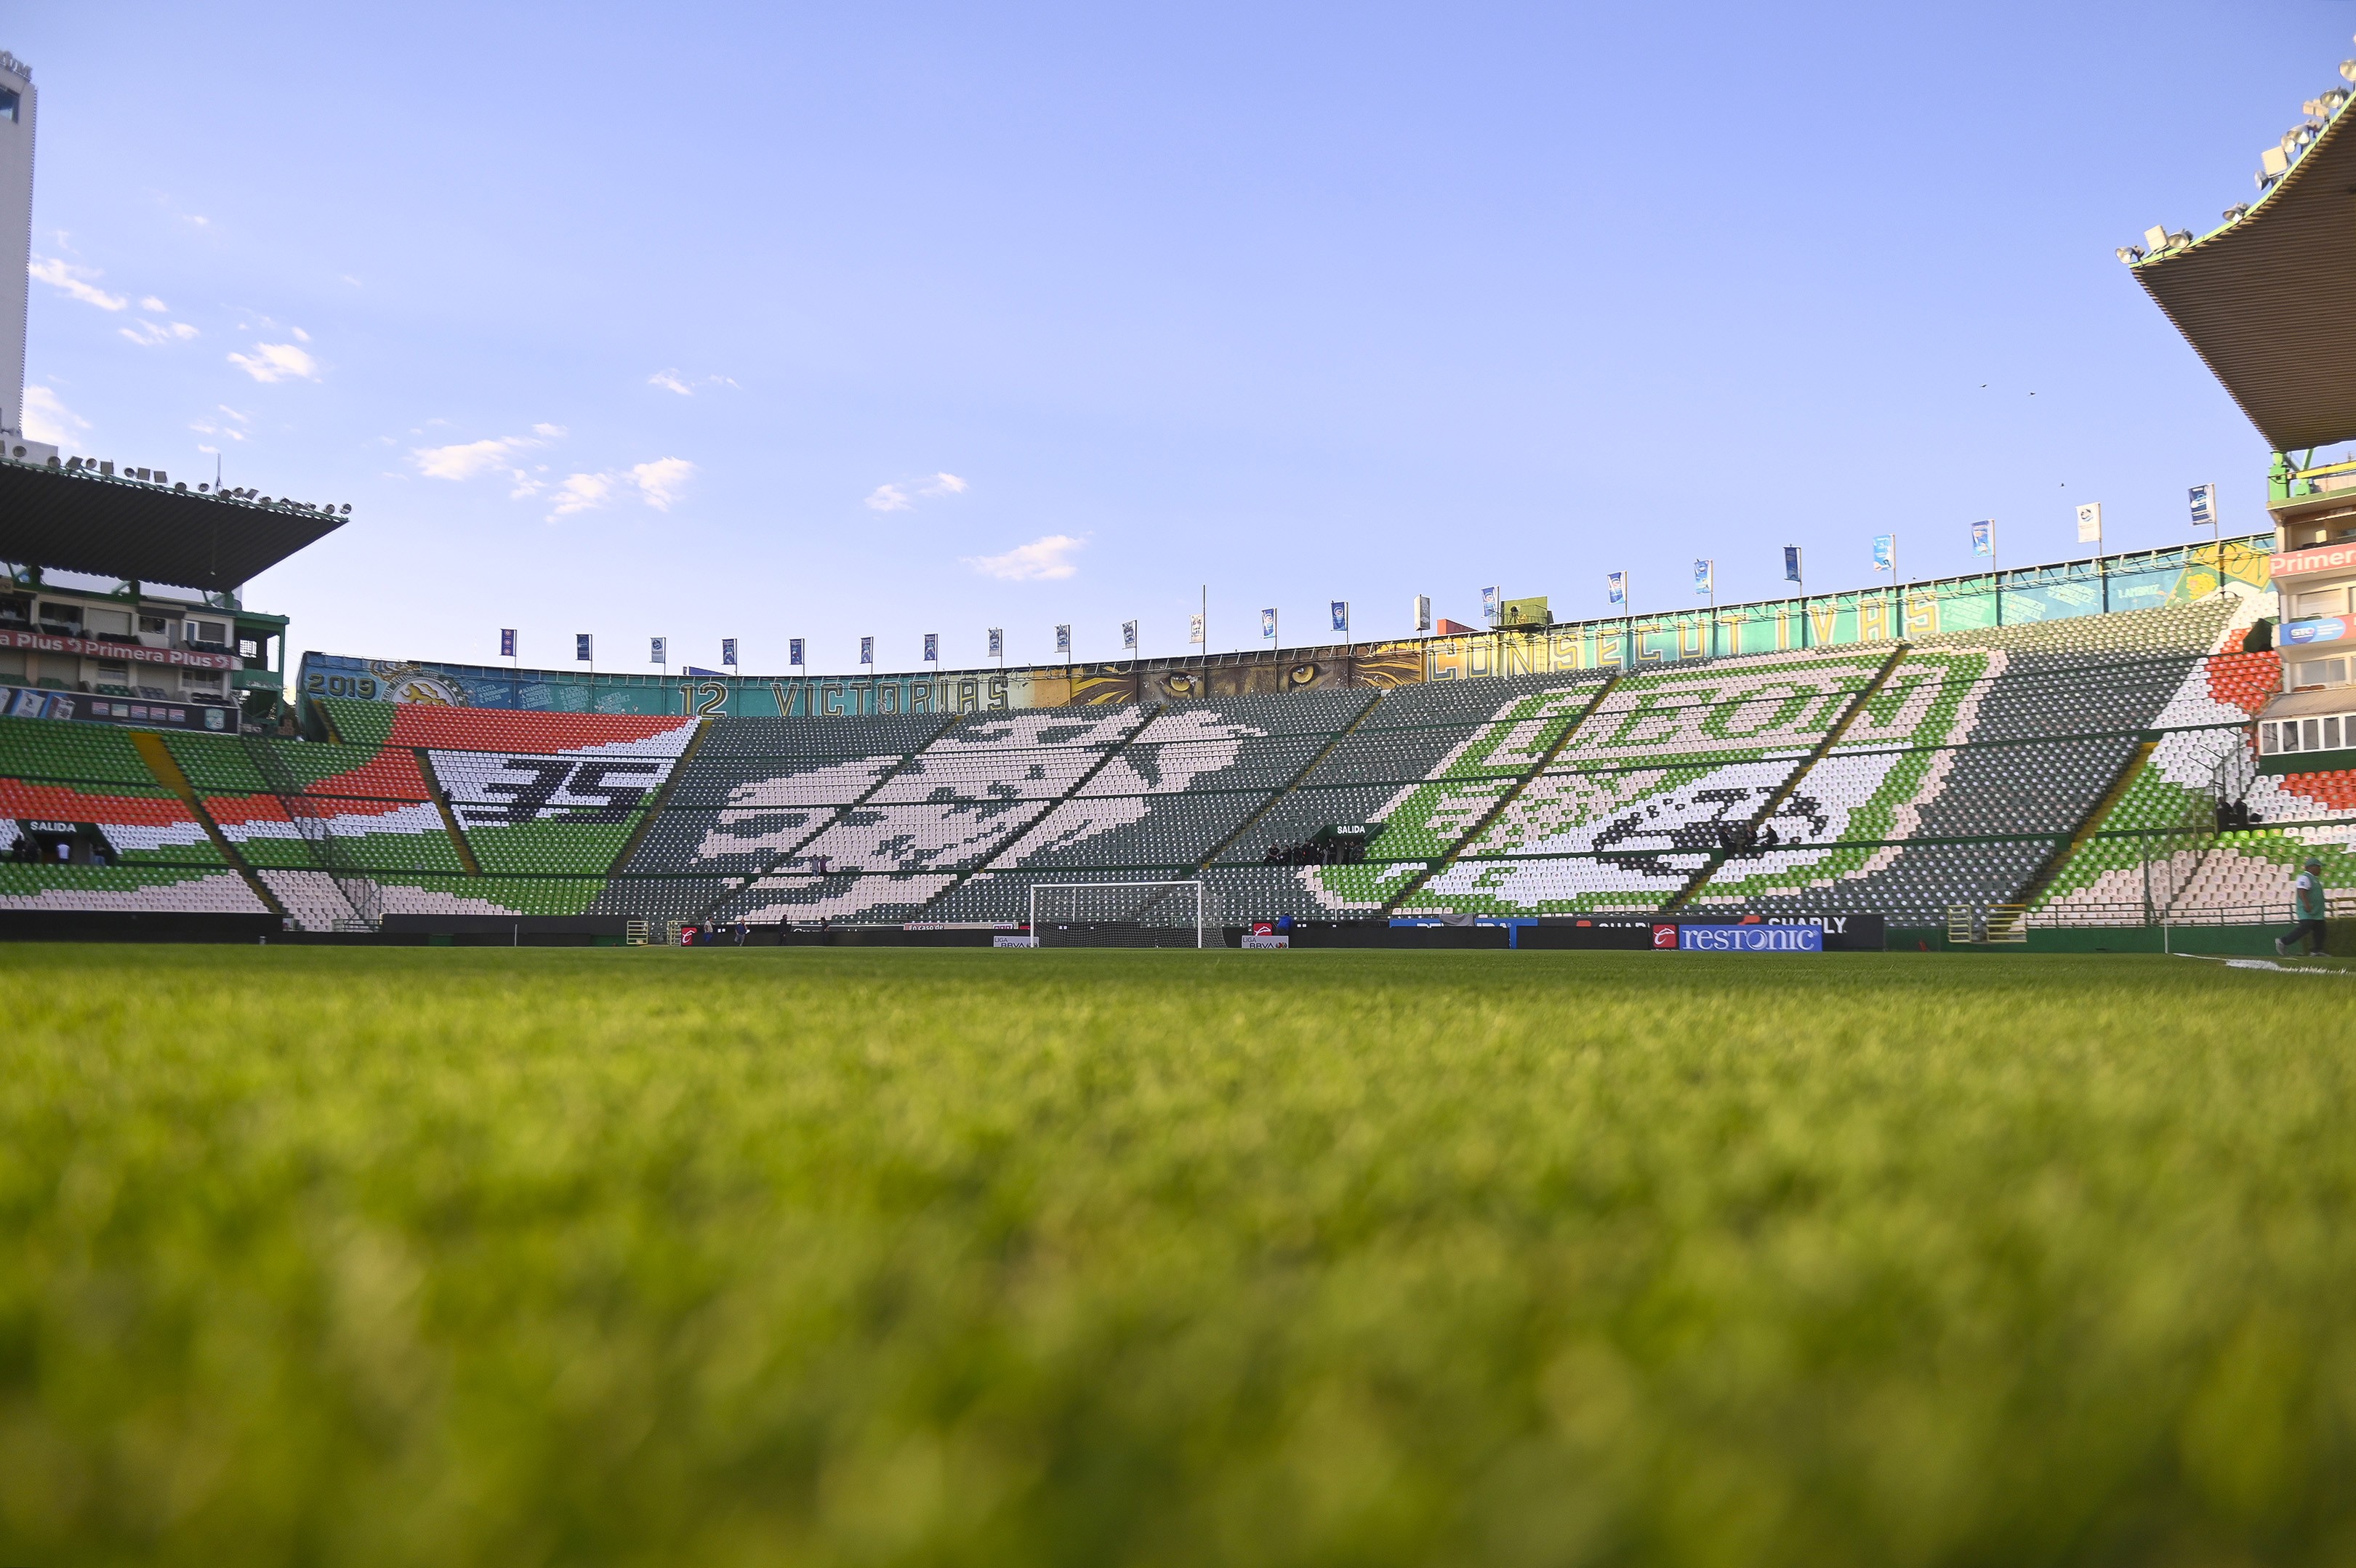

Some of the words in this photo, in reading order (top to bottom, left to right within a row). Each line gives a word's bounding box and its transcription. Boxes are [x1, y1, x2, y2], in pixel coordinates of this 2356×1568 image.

[2270, 549, 2356, 574] Primer
[1425, 587, 1940, 684] CONSECUTIVAS
[16, 633, 63, 651] Plus
[85, 640, 165, 663] Primera
[169, 651, 212, 668] Plus
[307, 672, 377, 700] 2019
[679, 682, 728, 717] 12
[771, 676, 1010, 717] VICTORIAS
[30, 821, 77, 832] SALIDA
[1337, 825, 1366, 835] SALIDA
